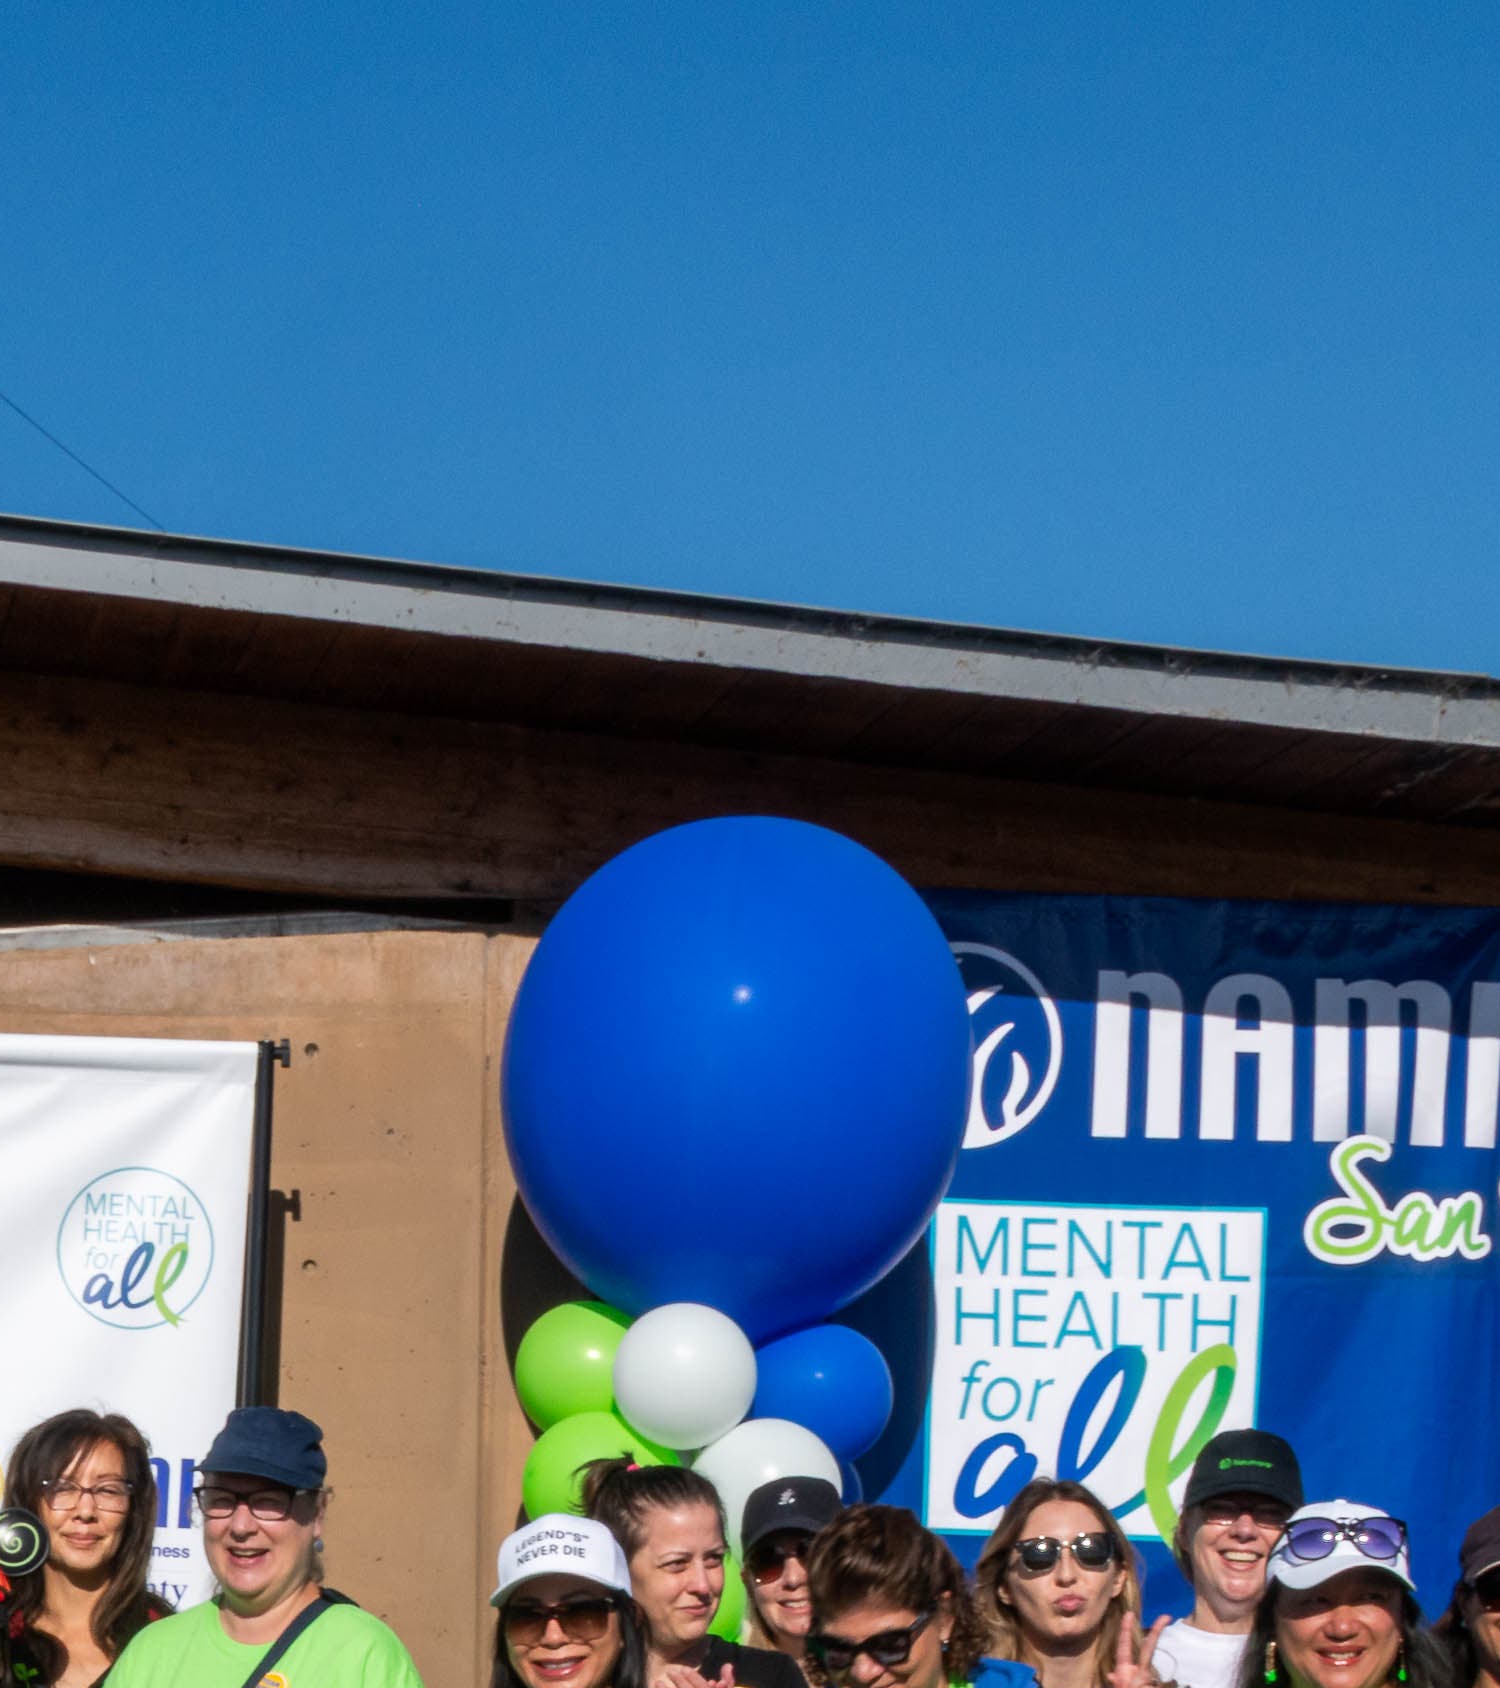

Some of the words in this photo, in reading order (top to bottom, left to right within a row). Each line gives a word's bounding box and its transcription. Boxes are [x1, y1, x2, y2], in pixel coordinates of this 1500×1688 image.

[83, 1217, 190, 1245] HEALTH
[84, 1193, 195, 1220] MENTAL
[1305, 1136, 1490, 1264] San
[83, 1246, 121, 1270] for
[954, 1214, 1251, 1283] MENTAL
[83, 1242, 189, 1328] all
[953, 1286, 1237, 1353] HEALTH
[958, 1360, 1055, 1422] for
[516, 1545, 560, 1567] NEVER
[563, 1545, 586, 1559] DIE
